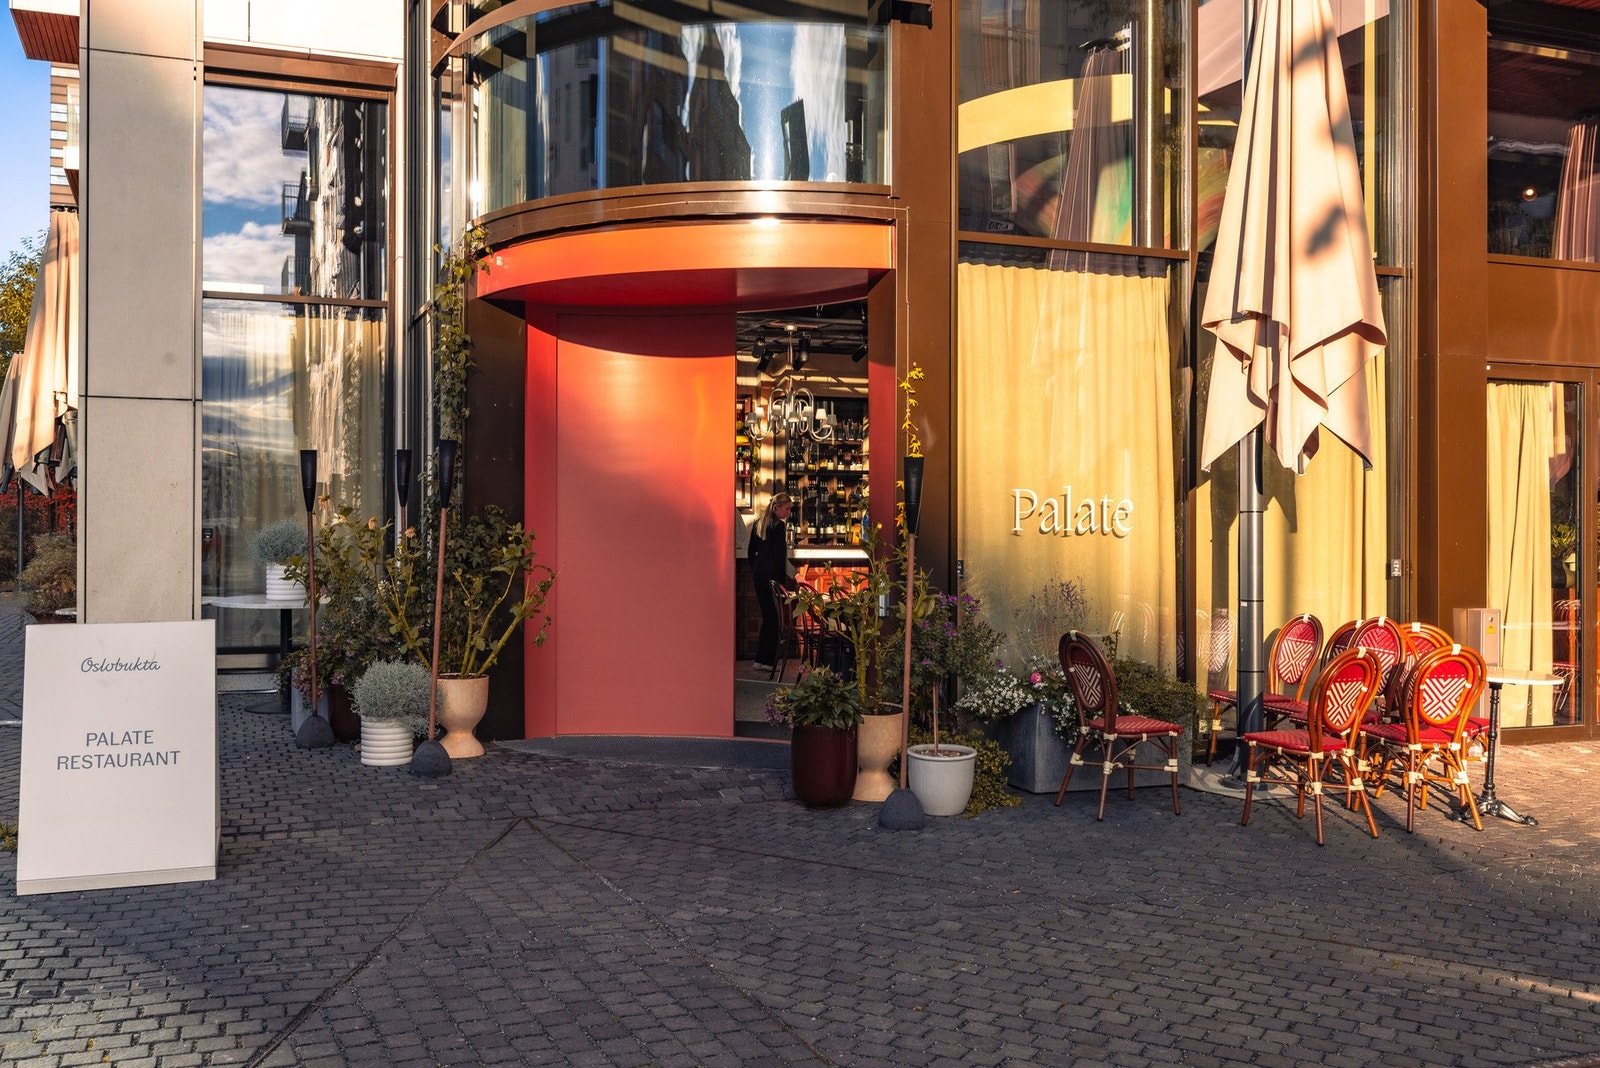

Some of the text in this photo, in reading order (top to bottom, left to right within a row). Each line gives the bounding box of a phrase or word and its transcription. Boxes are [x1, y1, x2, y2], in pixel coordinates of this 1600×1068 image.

[1011, 485, 1134, 534] Palate
[80, 656, 161, 673] Oslobukta
[86, 729, 154, 747] PALATE
[57, 750, 181, 770] RESTAURANT
